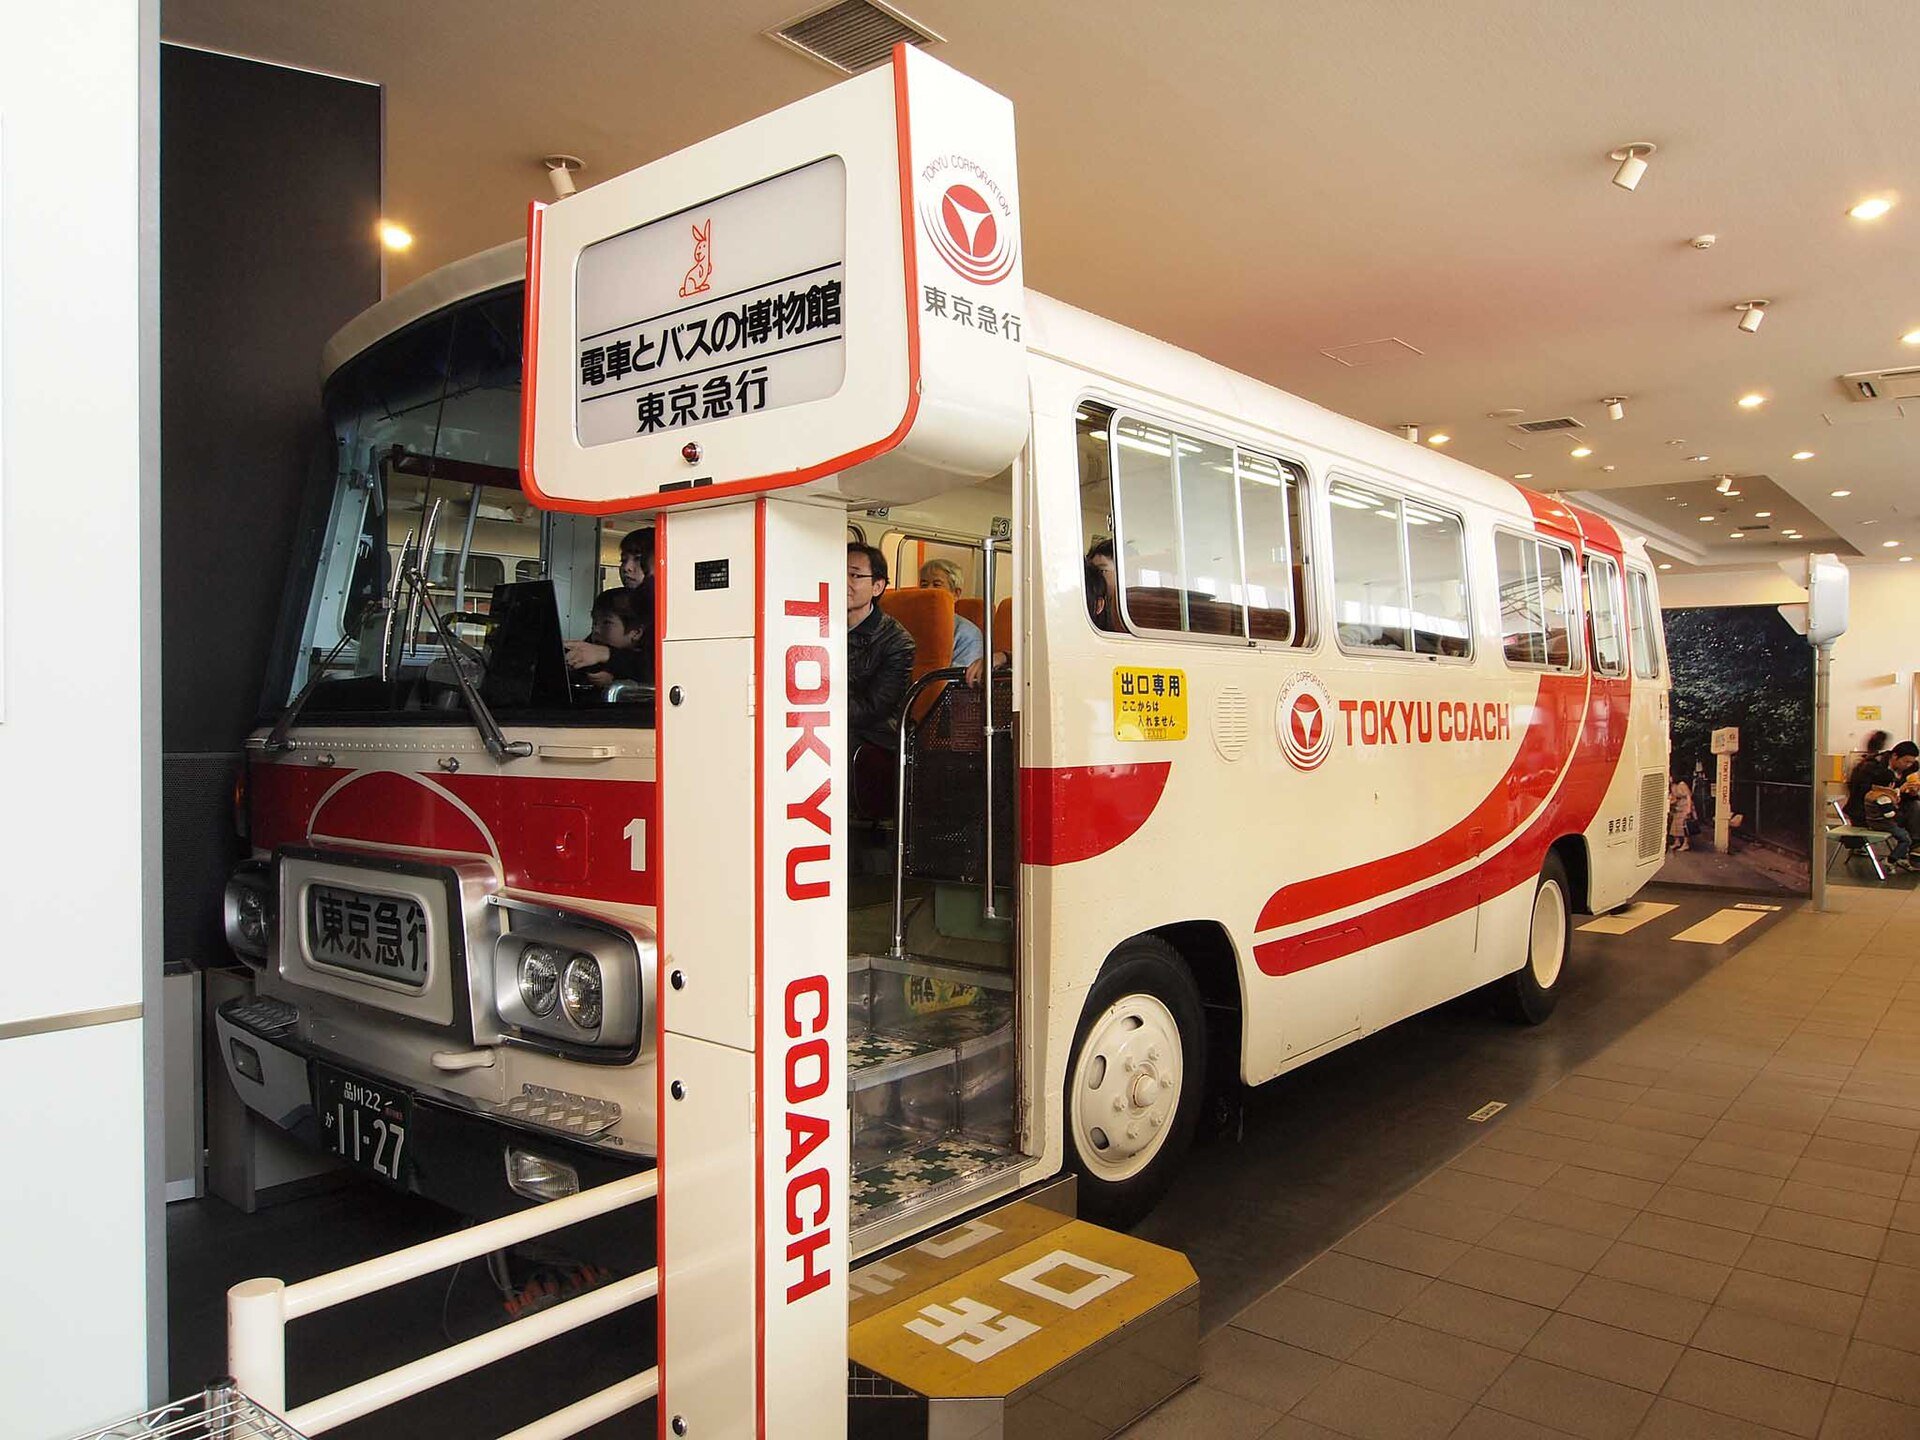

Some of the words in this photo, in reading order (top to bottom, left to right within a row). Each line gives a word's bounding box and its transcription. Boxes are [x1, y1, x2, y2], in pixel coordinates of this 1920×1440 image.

[921, 154, 949, 184] TOKYU
[950, 154, 1011, 217] CORPORATION
[580, 279, 842, 387] 電車とバスの博物館
[923, 285, 1022, 343] 東京急行
[636, 366, 768, 433] 東京急行
[1121, 672, 1180, 697] 出口専用
[1122, 700, 1160, 712] ここからは
[784, 582, 832, 902] TOKYU
[1138, 714, 1176, 727] 入れません
[1339, 700, 1433, 746] TOKYU
[1437, 701, 1510, 742] COACH
[623, 818, 646, 871] 1
[784, 974, 832, 1306] COACH
[902, 1249, 1135, 1363] 出口
